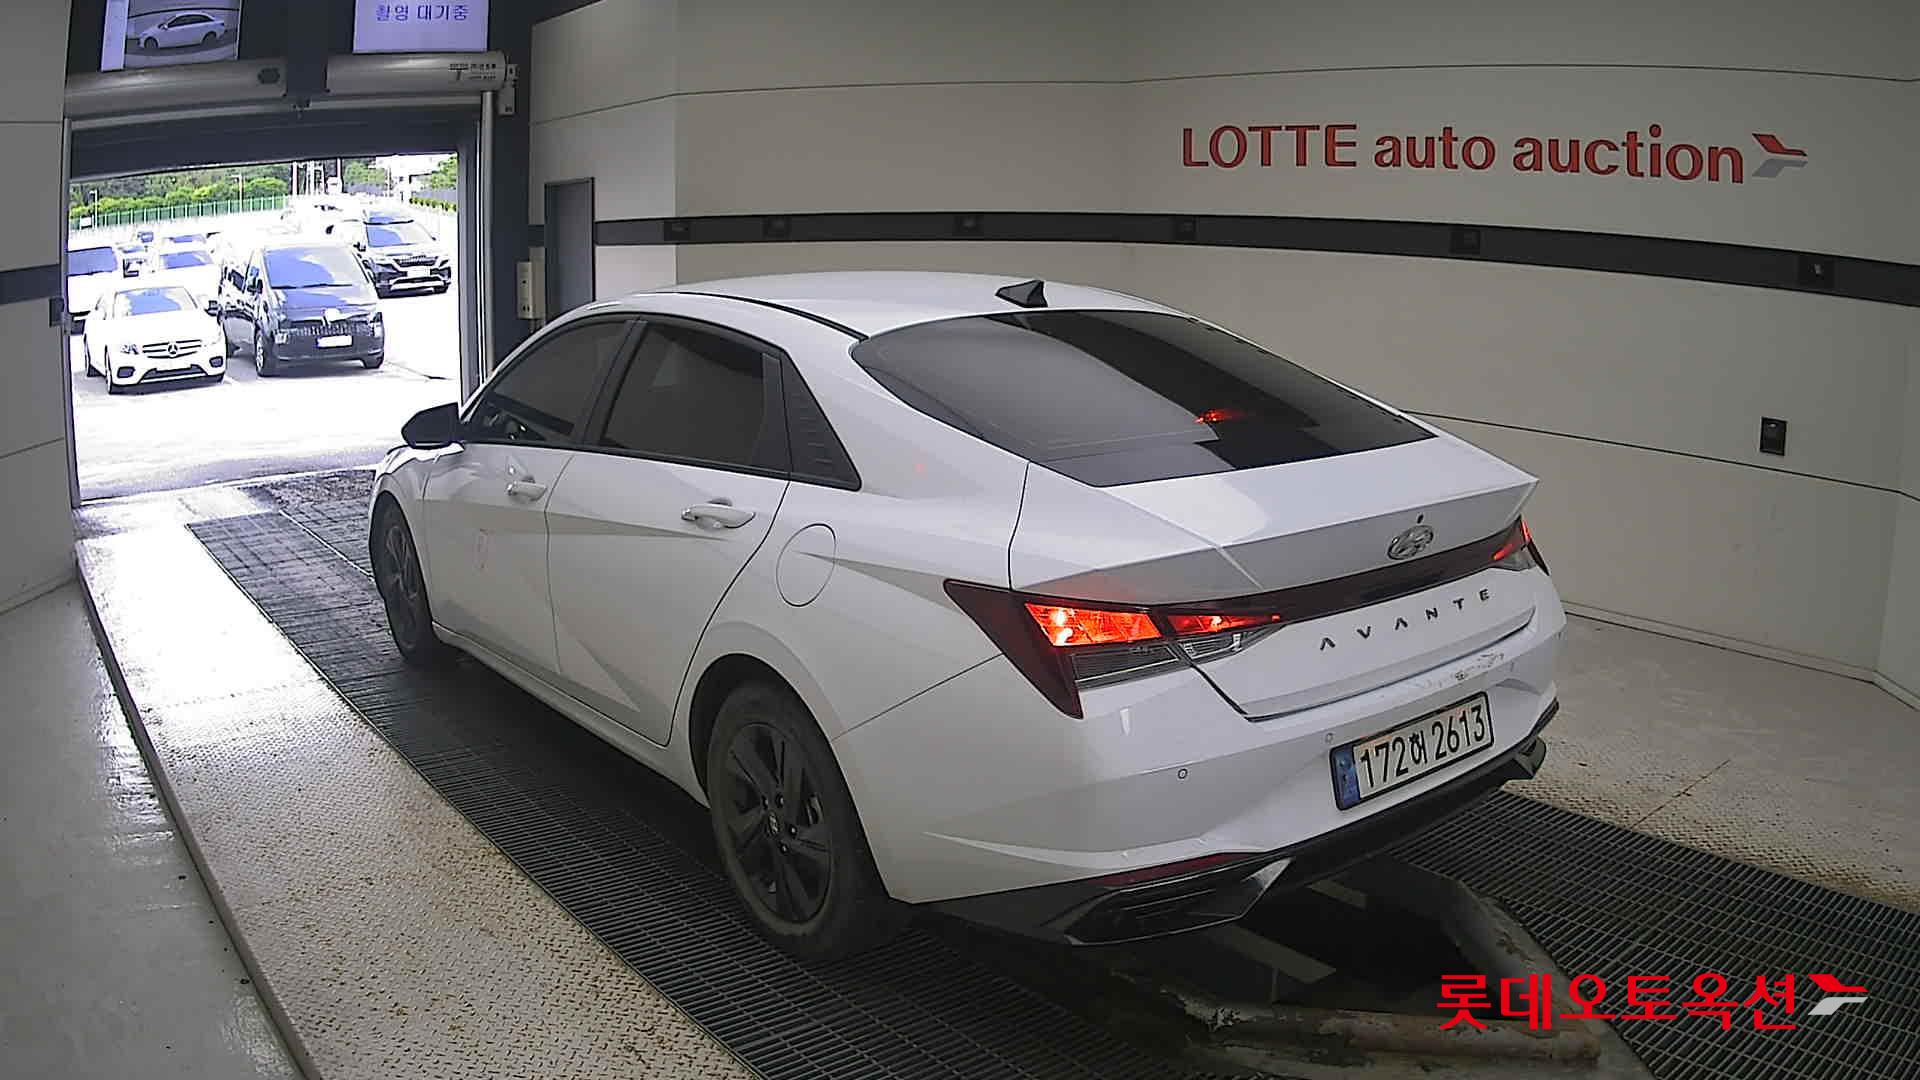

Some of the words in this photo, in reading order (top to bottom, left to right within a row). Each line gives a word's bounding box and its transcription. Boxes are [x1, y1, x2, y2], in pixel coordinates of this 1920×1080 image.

[376, 4, 409, 22] 촬영
[417, 4, 470, 21] 대기중
[1183, 124, 1358, 168] LOTTE
[1374, 126, 1497, 171] auto
[1512, 123, 1745, 184] auction
[1320, 588, 1490, 651] AVANTE
[1360, 730, 1428, 788] 172허
[1432, 705, 1485, 761] 2613
